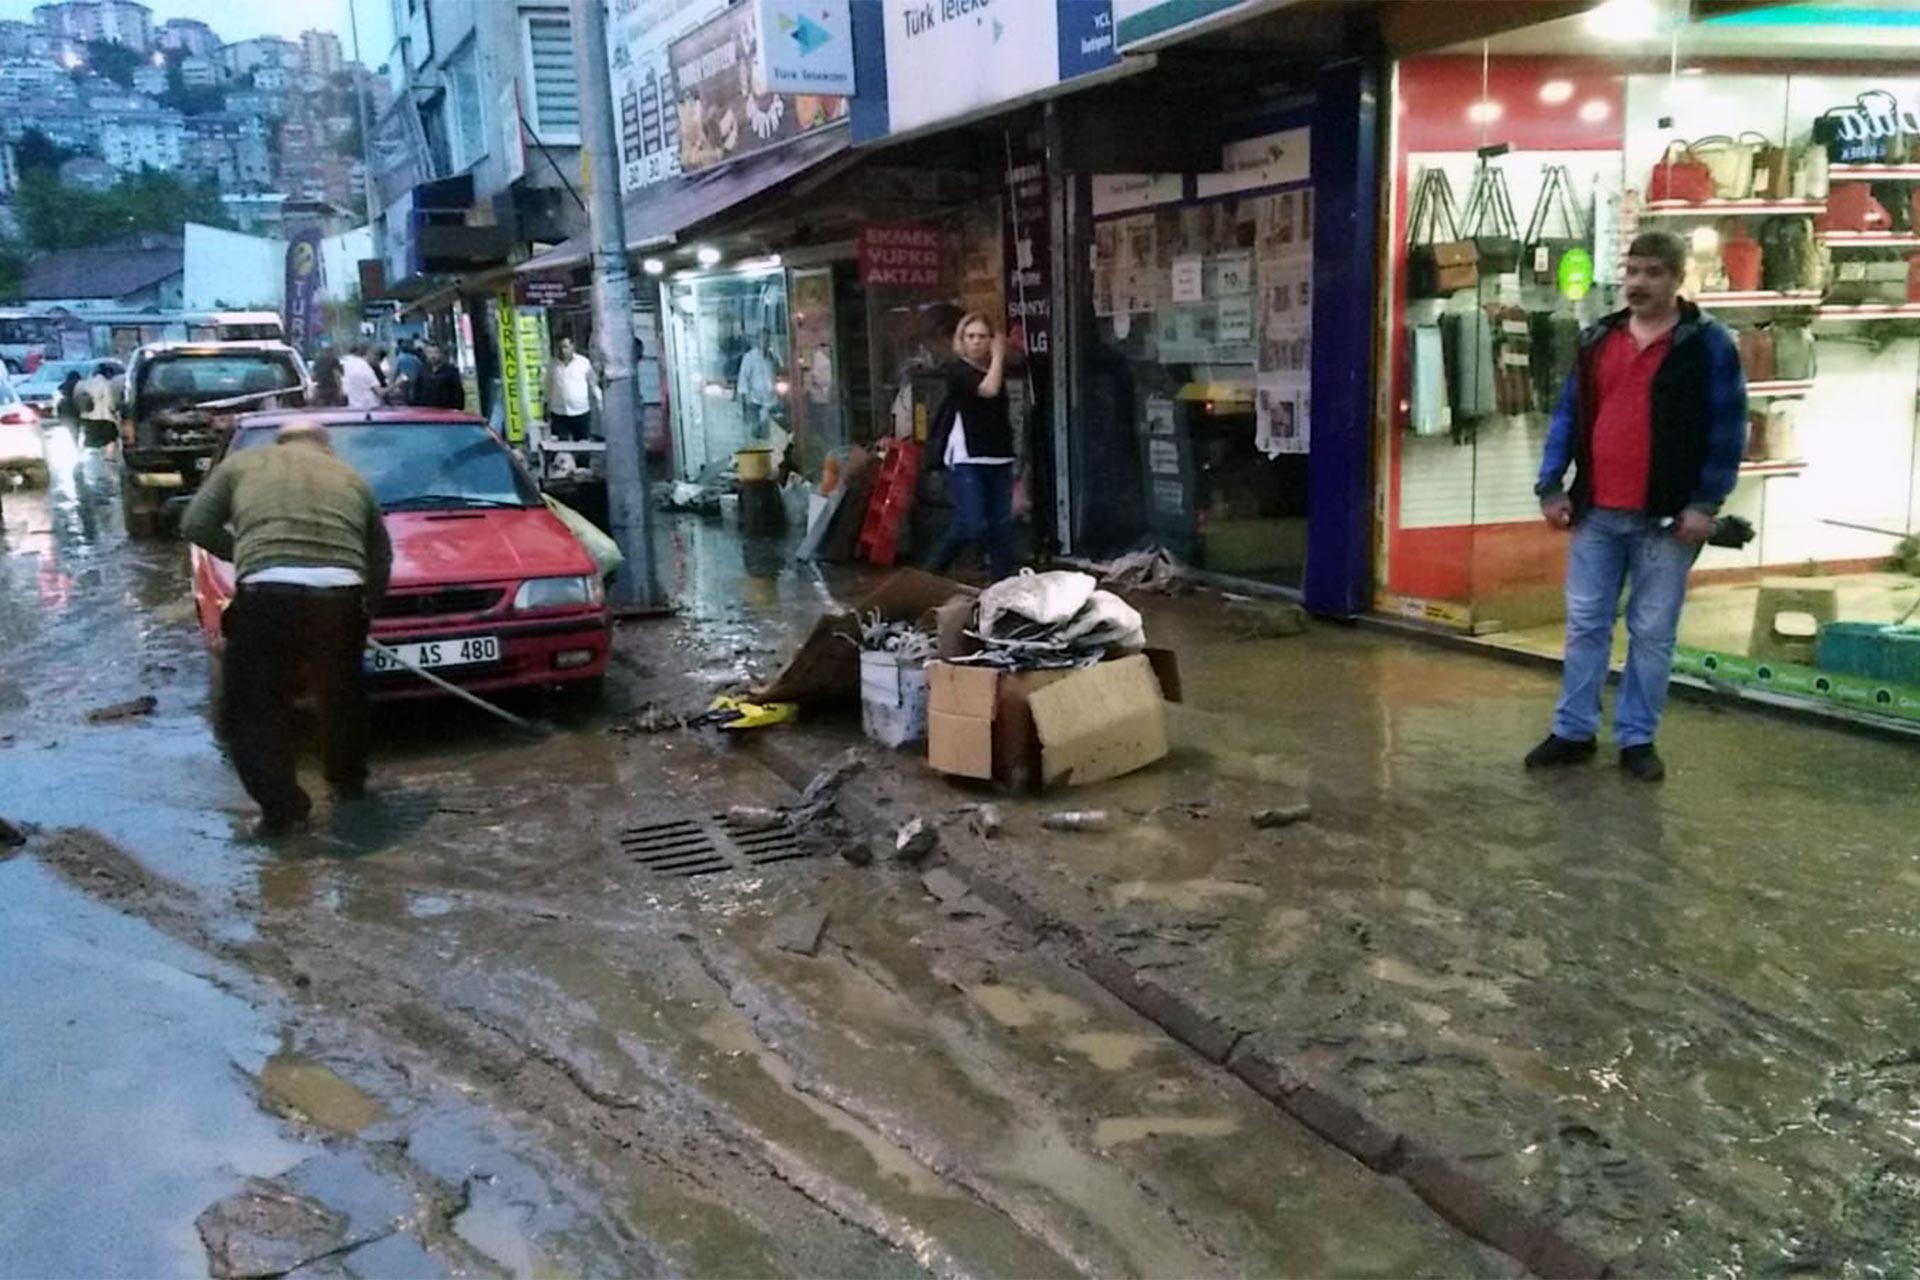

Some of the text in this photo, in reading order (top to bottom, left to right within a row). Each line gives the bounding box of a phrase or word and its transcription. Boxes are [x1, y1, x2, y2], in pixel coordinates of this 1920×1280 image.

[903, 2, 935, 38] Türk
[867, 267, 939, 284] AKTAR
[1030, 331, 1048, 352] LG
[501, 292, 520, 433] TURKCELL
[419, 644, 442, 665] AS
[460, 639, 496, 660] 480
